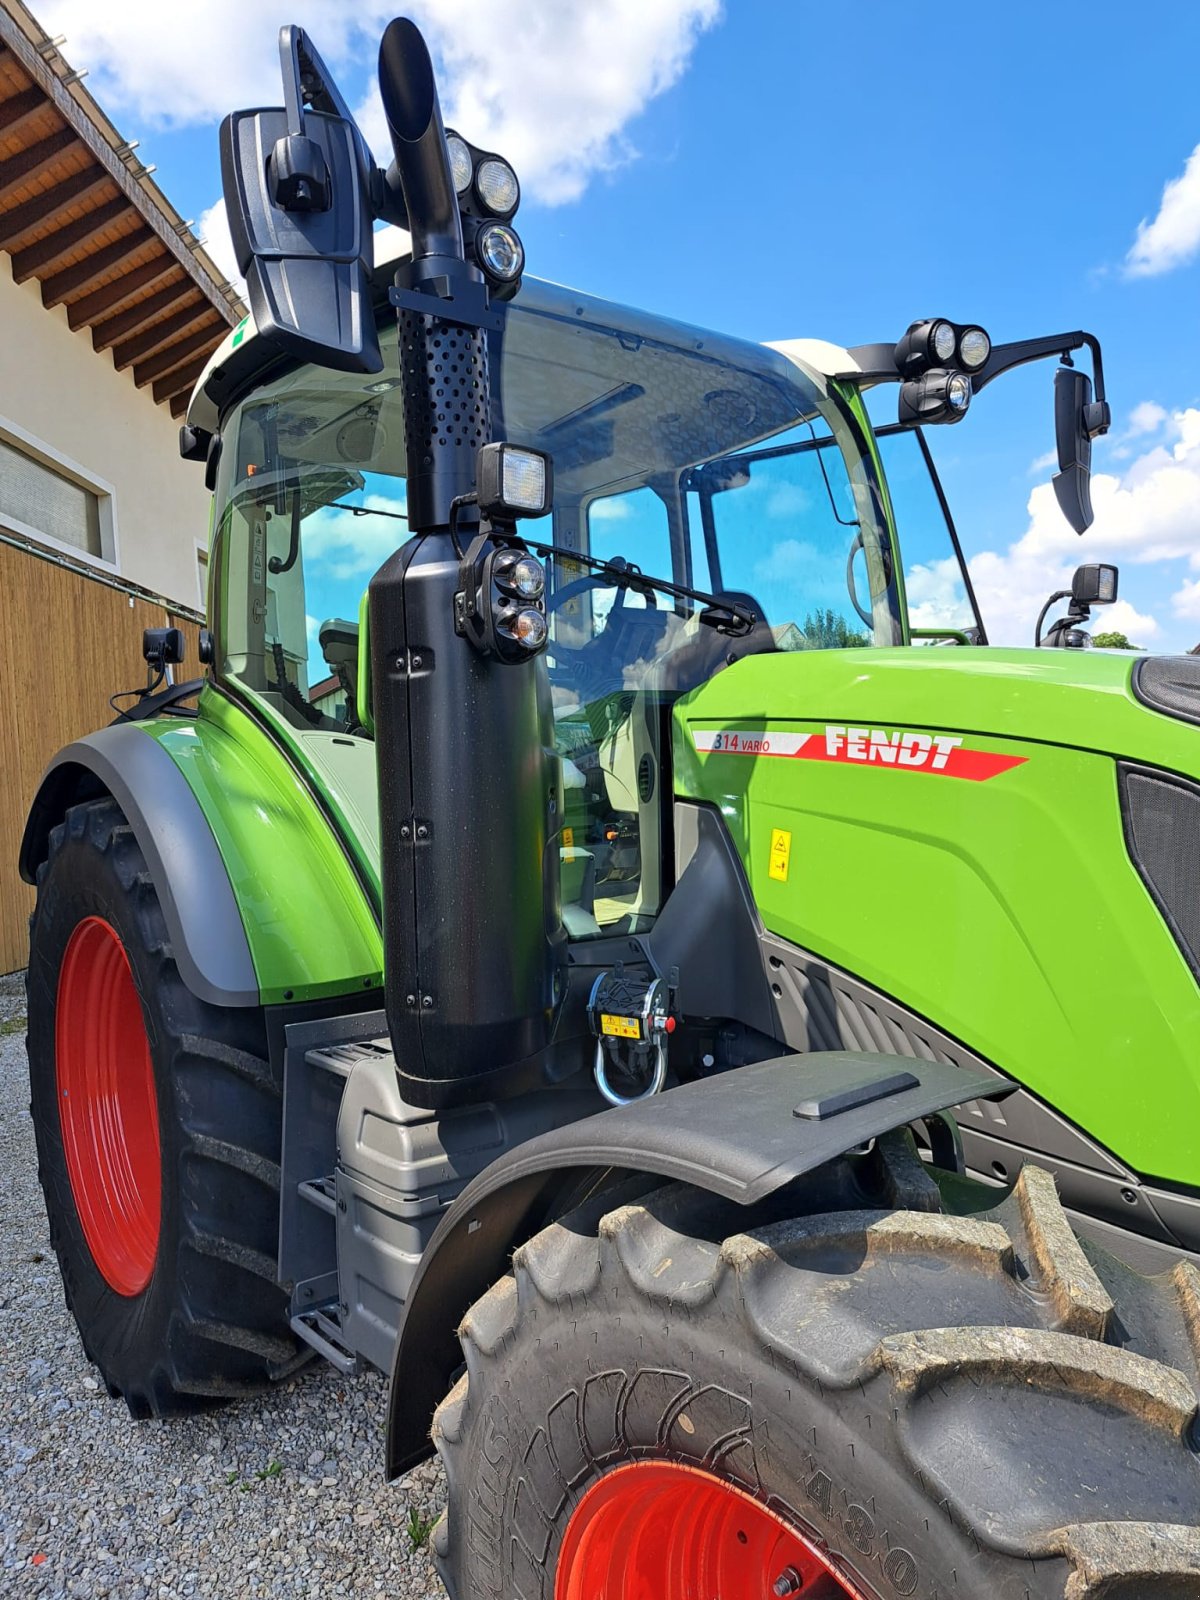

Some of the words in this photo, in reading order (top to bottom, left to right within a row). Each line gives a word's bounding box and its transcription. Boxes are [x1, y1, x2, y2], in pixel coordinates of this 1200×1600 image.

[714, 734, 738, 750] 314
[742, 740, 770, 752] VARIO
[825, 725, 964, 769] FENDT
